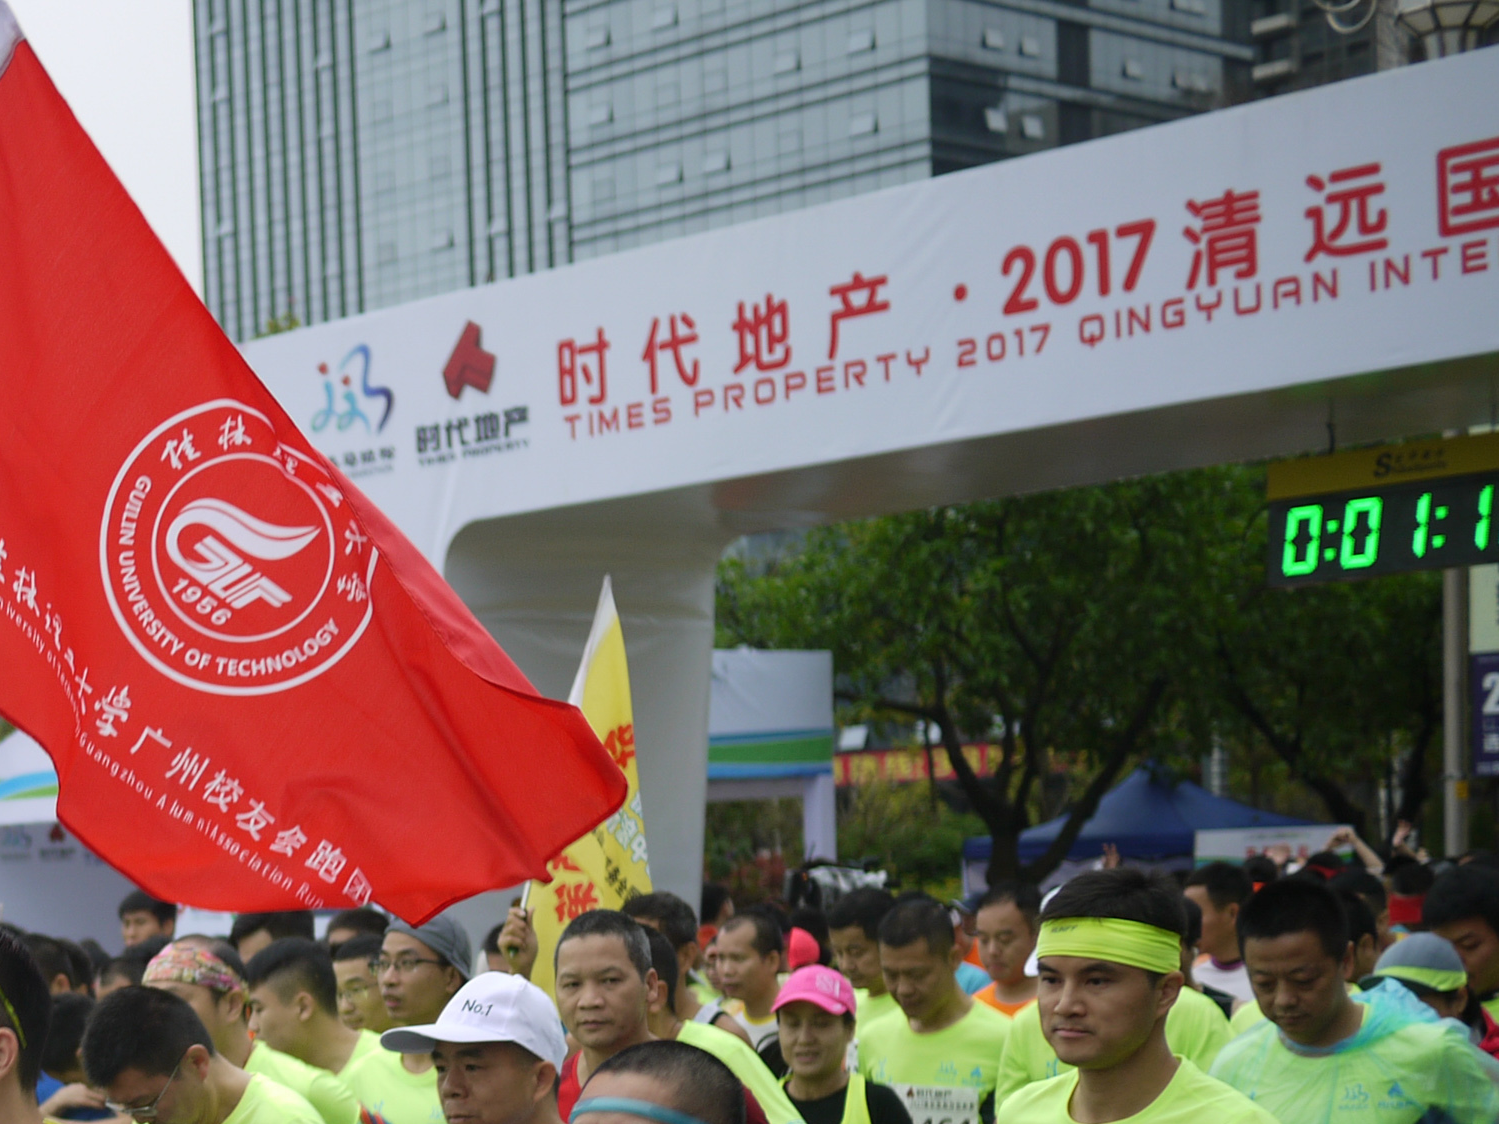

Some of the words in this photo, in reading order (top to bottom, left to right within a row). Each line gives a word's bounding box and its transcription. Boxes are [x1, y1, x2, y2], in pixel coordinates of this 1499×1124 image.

[564, 397, 672, 440] TIMES
[694, 346, 930, 417] PROPERTY
[957, 323, 1052, 368] 2017
[1079, 269, 1338, 347] QINGYUAN
[1369, 239, 1488, 292] INTE
[415, 406, 529, 454] 时代地产
[118, 474, 152, 546] GUILIN
[118, 550, 184, 652] UNIVERSITY
[172, 577, 232, 625] 1956
[184, 648, 212, 671] OF
[215, 617, 340, 677] TECHNOLOGY
[79, 731, 153, 801] Guangzhou
[461, 999, 493, 1016] No.1
